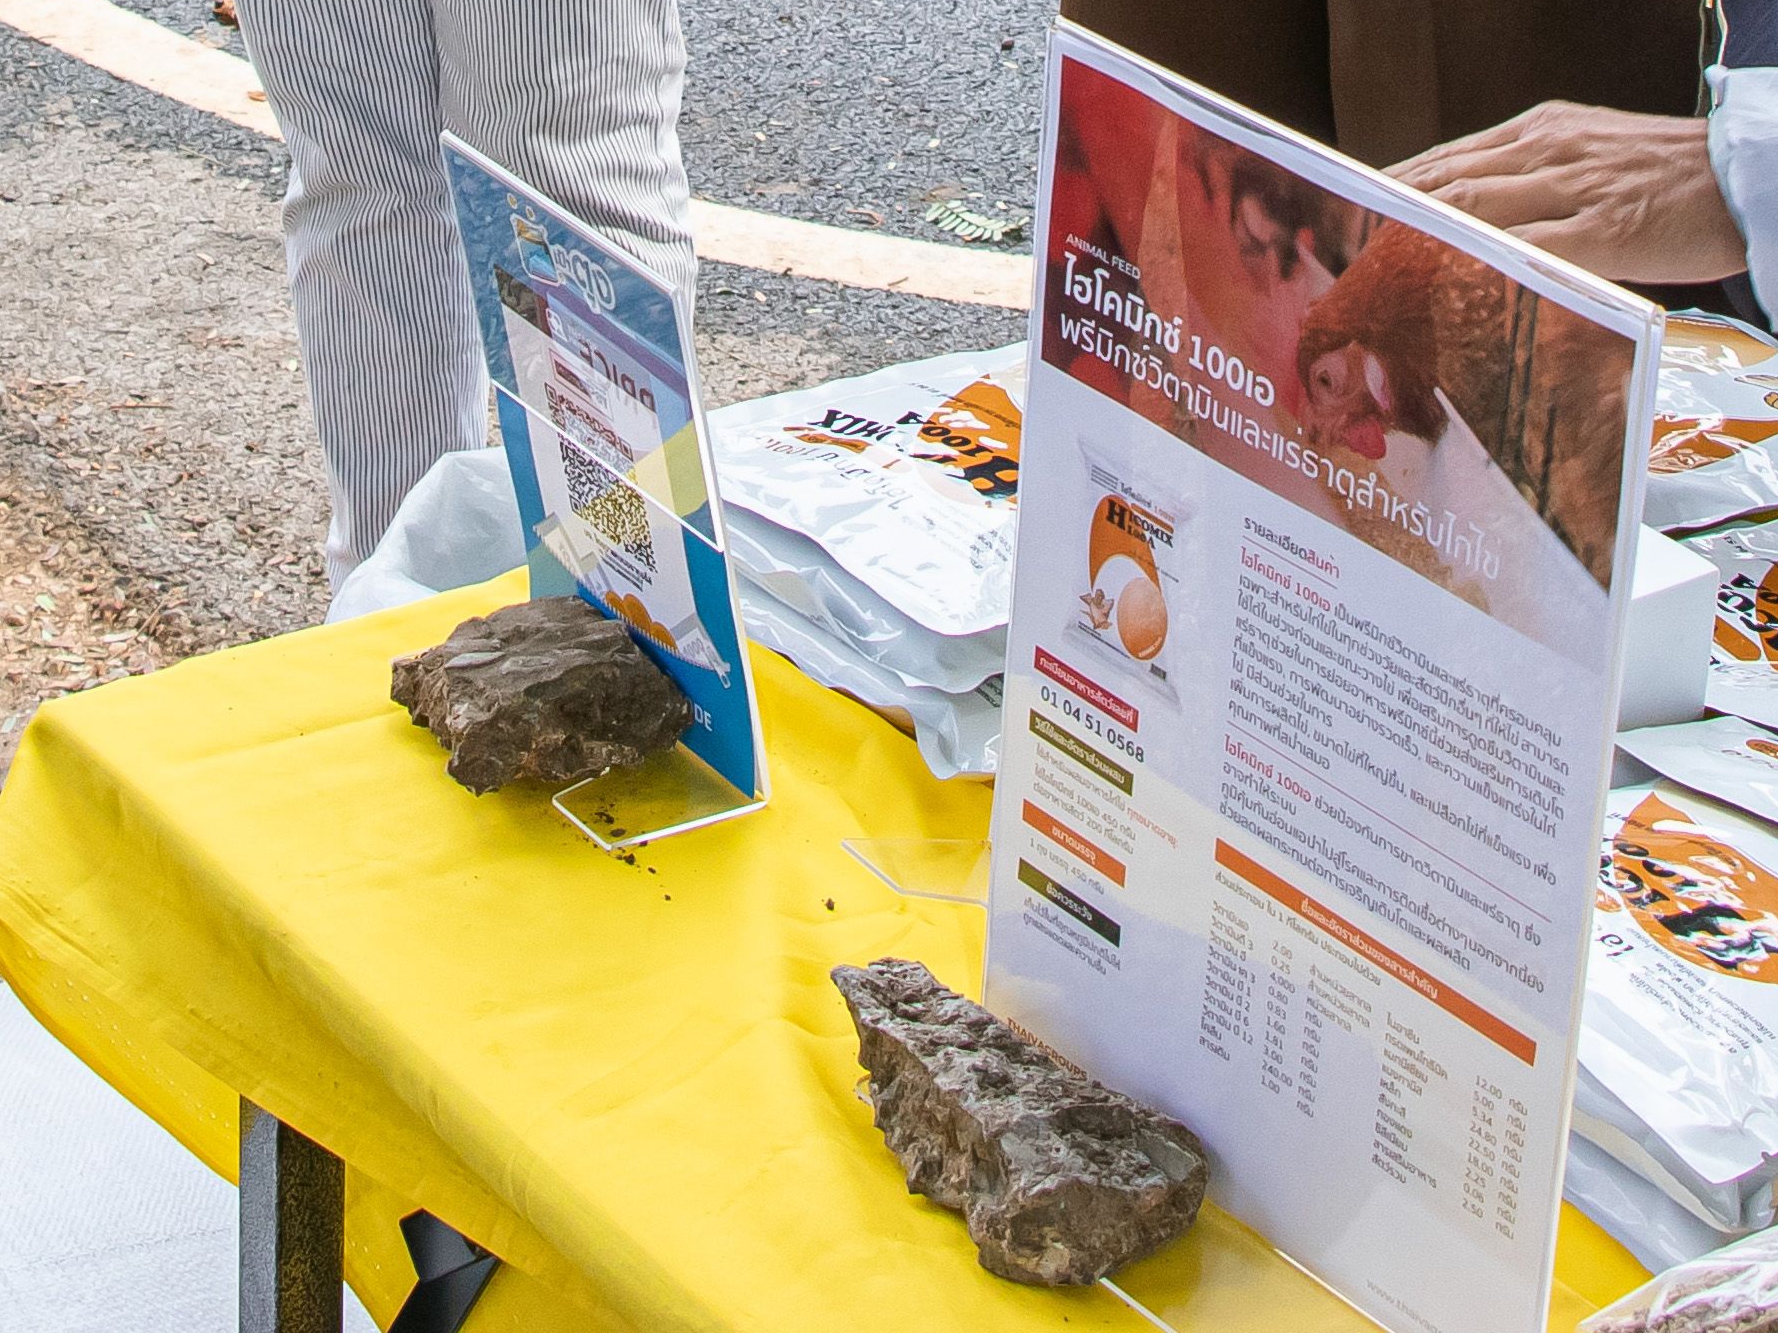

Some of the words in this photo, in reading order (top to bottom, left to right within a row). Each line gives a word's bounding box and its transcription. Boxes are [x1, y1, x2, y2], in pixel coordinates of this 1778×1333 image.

[1065, 232, 1108, 264] ANIMAL
[1111, 254, 1141, 280] FEED
[1061, 250, 1182, 353] ไฮโคมิกซ์
[1188, 334, 1276, 406] 100เอ
[1240, 545, 1291, 590] ไฮโคมิกซ์
[1294, 581, 1331, 612] 100เอ
[1244, 516, 1340, 578] รายละเอียดสินค้า
[1040, 683, 1058, 709] 01
[1062, 698, 1080, 723] 04
[1084, 712, 1102, 737] 51
[1106, 727, 1145, 763] 0568
[1246, 663, 1333, 728] มีส่วนช่วยในการ
[1224, 733, 1273, 779] ไฮโคมิกซ์
[1276, 771, 1311, 803] 100เอ
